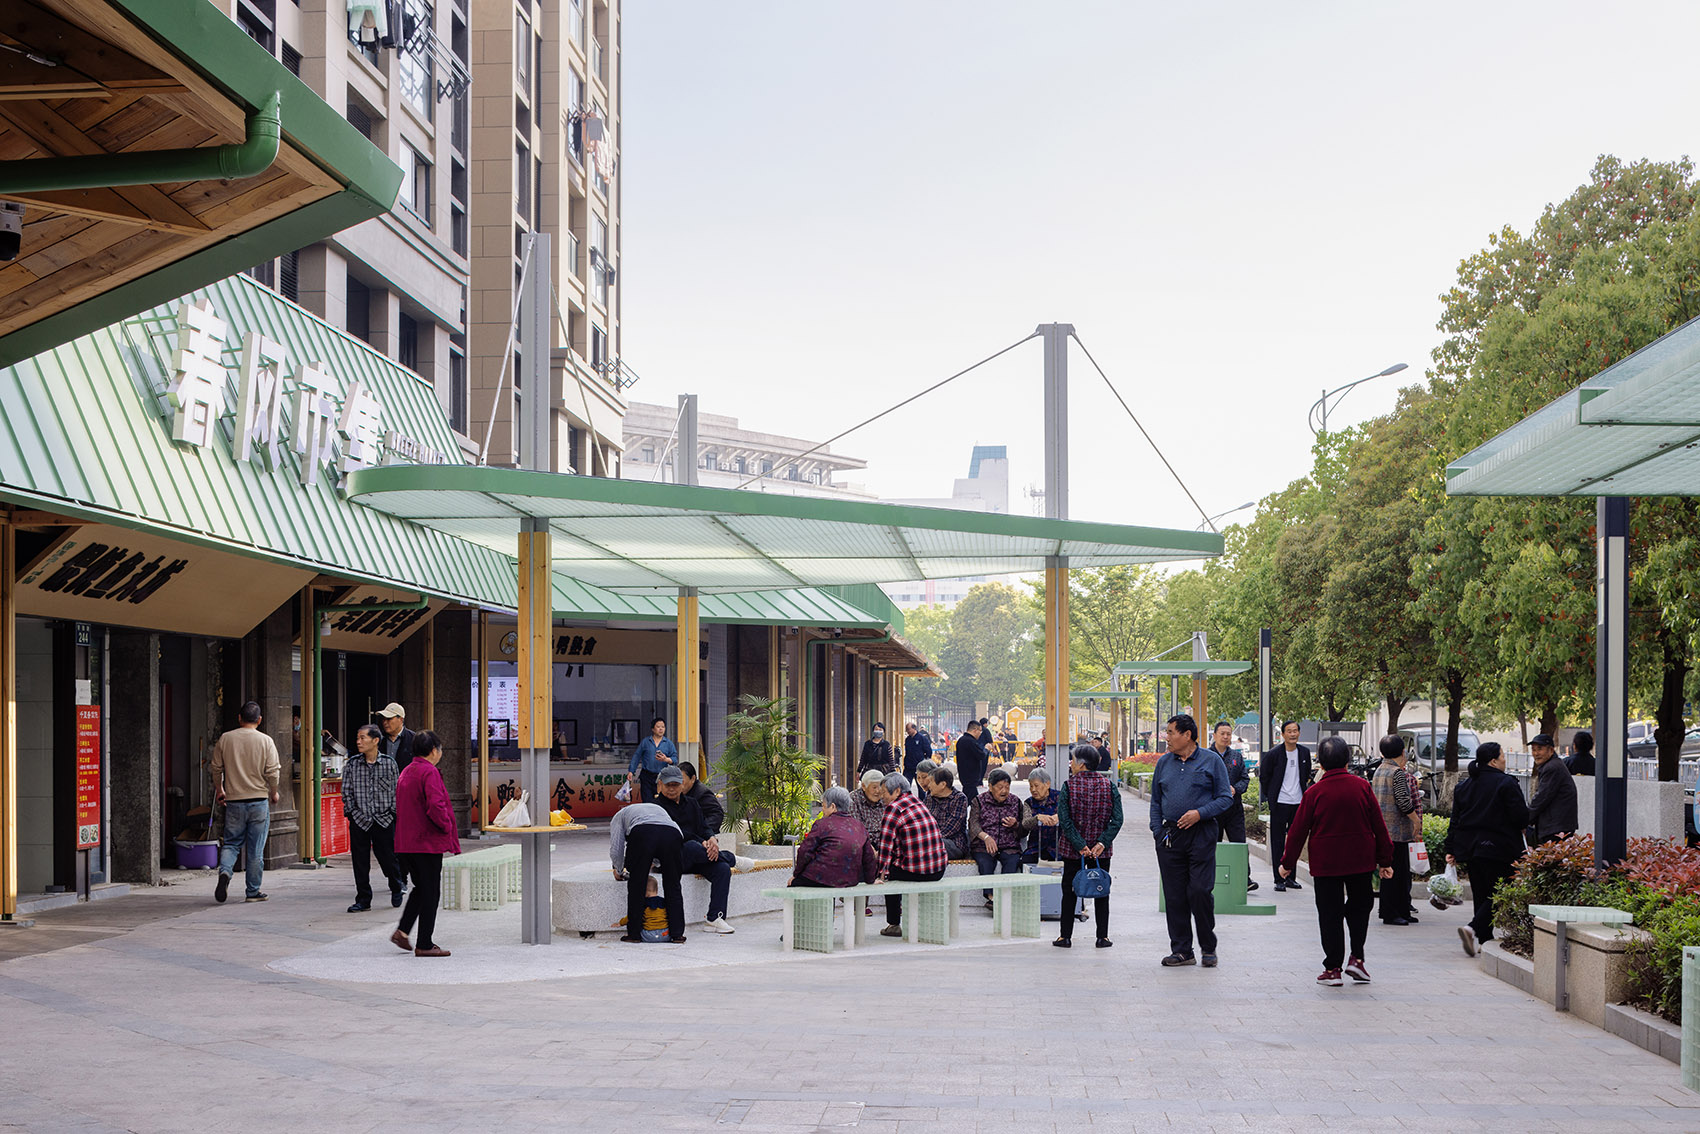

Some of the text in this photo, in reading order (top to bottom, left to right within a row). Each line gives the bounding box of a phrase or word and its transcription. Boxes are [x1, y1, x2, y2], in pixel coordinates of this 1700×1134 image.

[166, 298, 381, 493] 春风市集
[78, 631, 89, 643] 244
